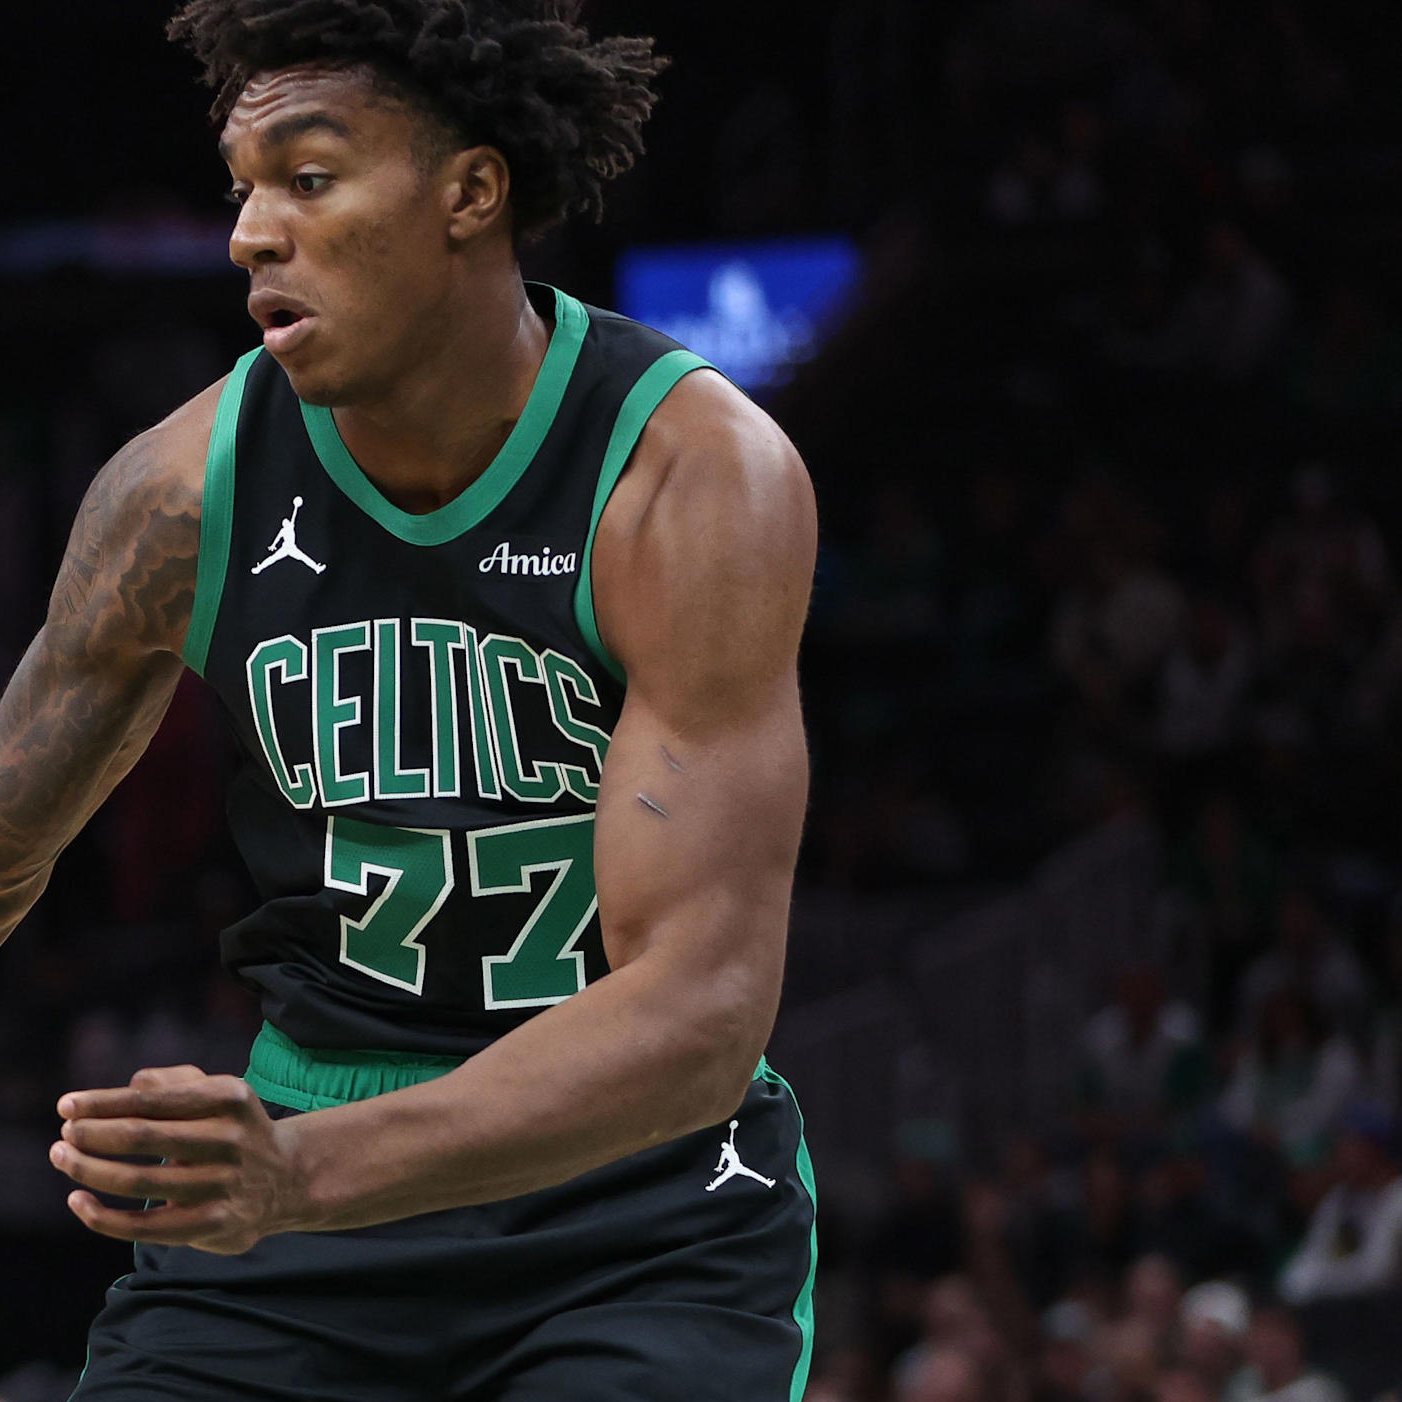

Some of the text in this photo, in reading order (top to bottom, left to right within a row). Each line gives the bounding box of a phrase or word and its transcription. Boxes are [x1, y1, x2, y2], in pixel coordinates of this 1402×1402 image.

[478, 542, 576, 576] Amica
[246, 618, 611, 809] CELTICS
[324, 812, 599, 1011] 77
